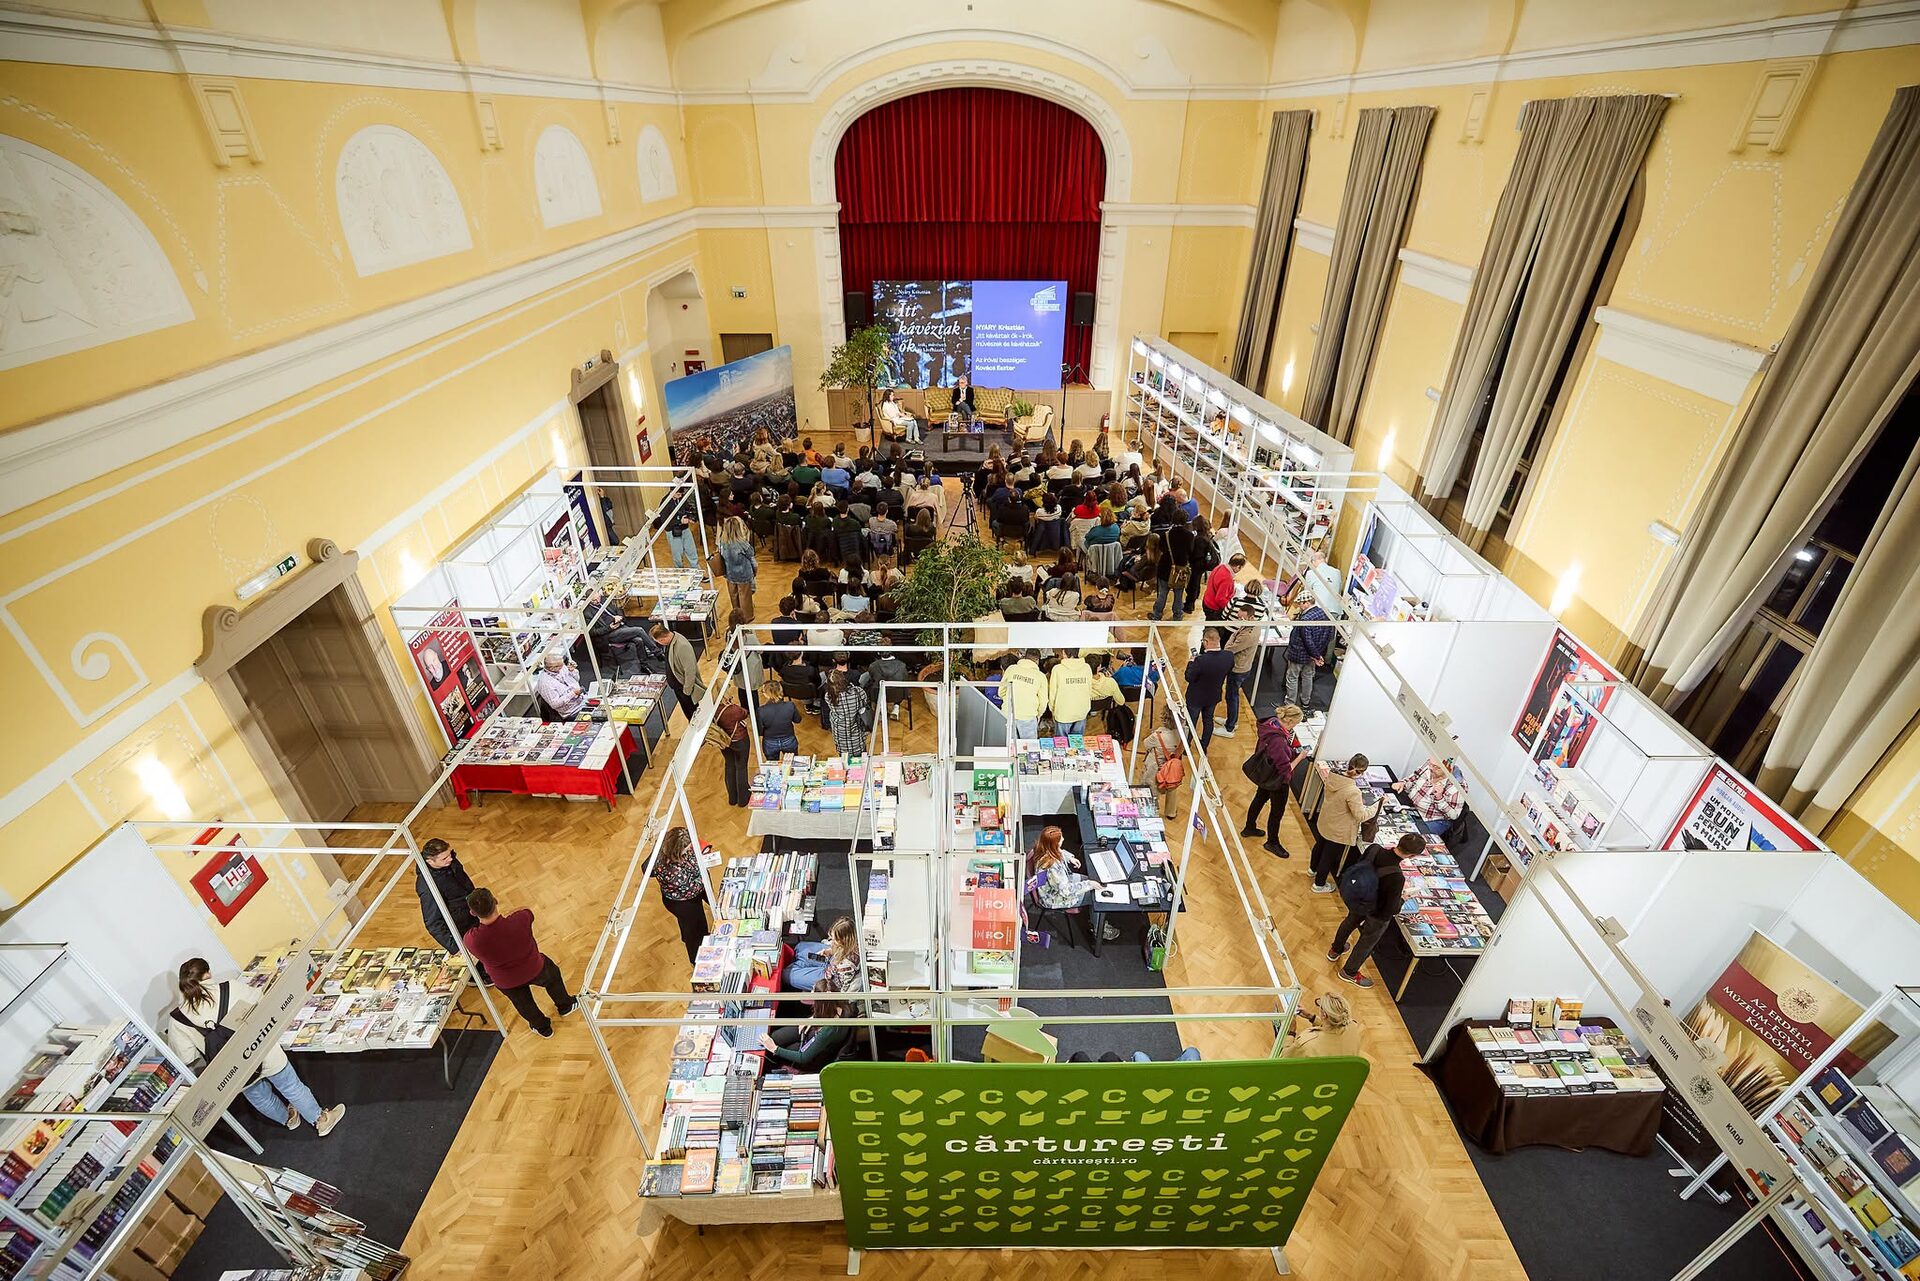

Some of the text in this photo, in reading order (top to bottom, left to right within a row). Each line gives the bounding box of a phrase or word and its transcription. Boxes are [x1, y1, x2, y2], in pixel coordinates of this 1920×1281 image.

[898, 299, 918, 318] Itt
[898, 320, 960, 340] kávéztak
[899, 337, 916, 353] ők
[1693, 821, 1700, 830] A
[1702, 801, 1740, 839] BUN
[1710, 795, 1745, 827] UN MOTIV
[1697, 814, 1731, 847] PENTRU
[1745, 1016, 1791, 1057] KIADÓJA
[1750, 997, 1768, 1011] AZ
[1768, 1010, 1813, 1048] ERDÉLYI
[216, 993, 295, 1092] EDITURA Corint KIADÓ
[1658, 1034, 1679, 1062] EDITURA
[1725, 1122, 1744, 1146] KIADÓ
[944, 1132, 1229, 1156] cărturești
[1033, 1156, 1138, 1166] cărturești.ro
